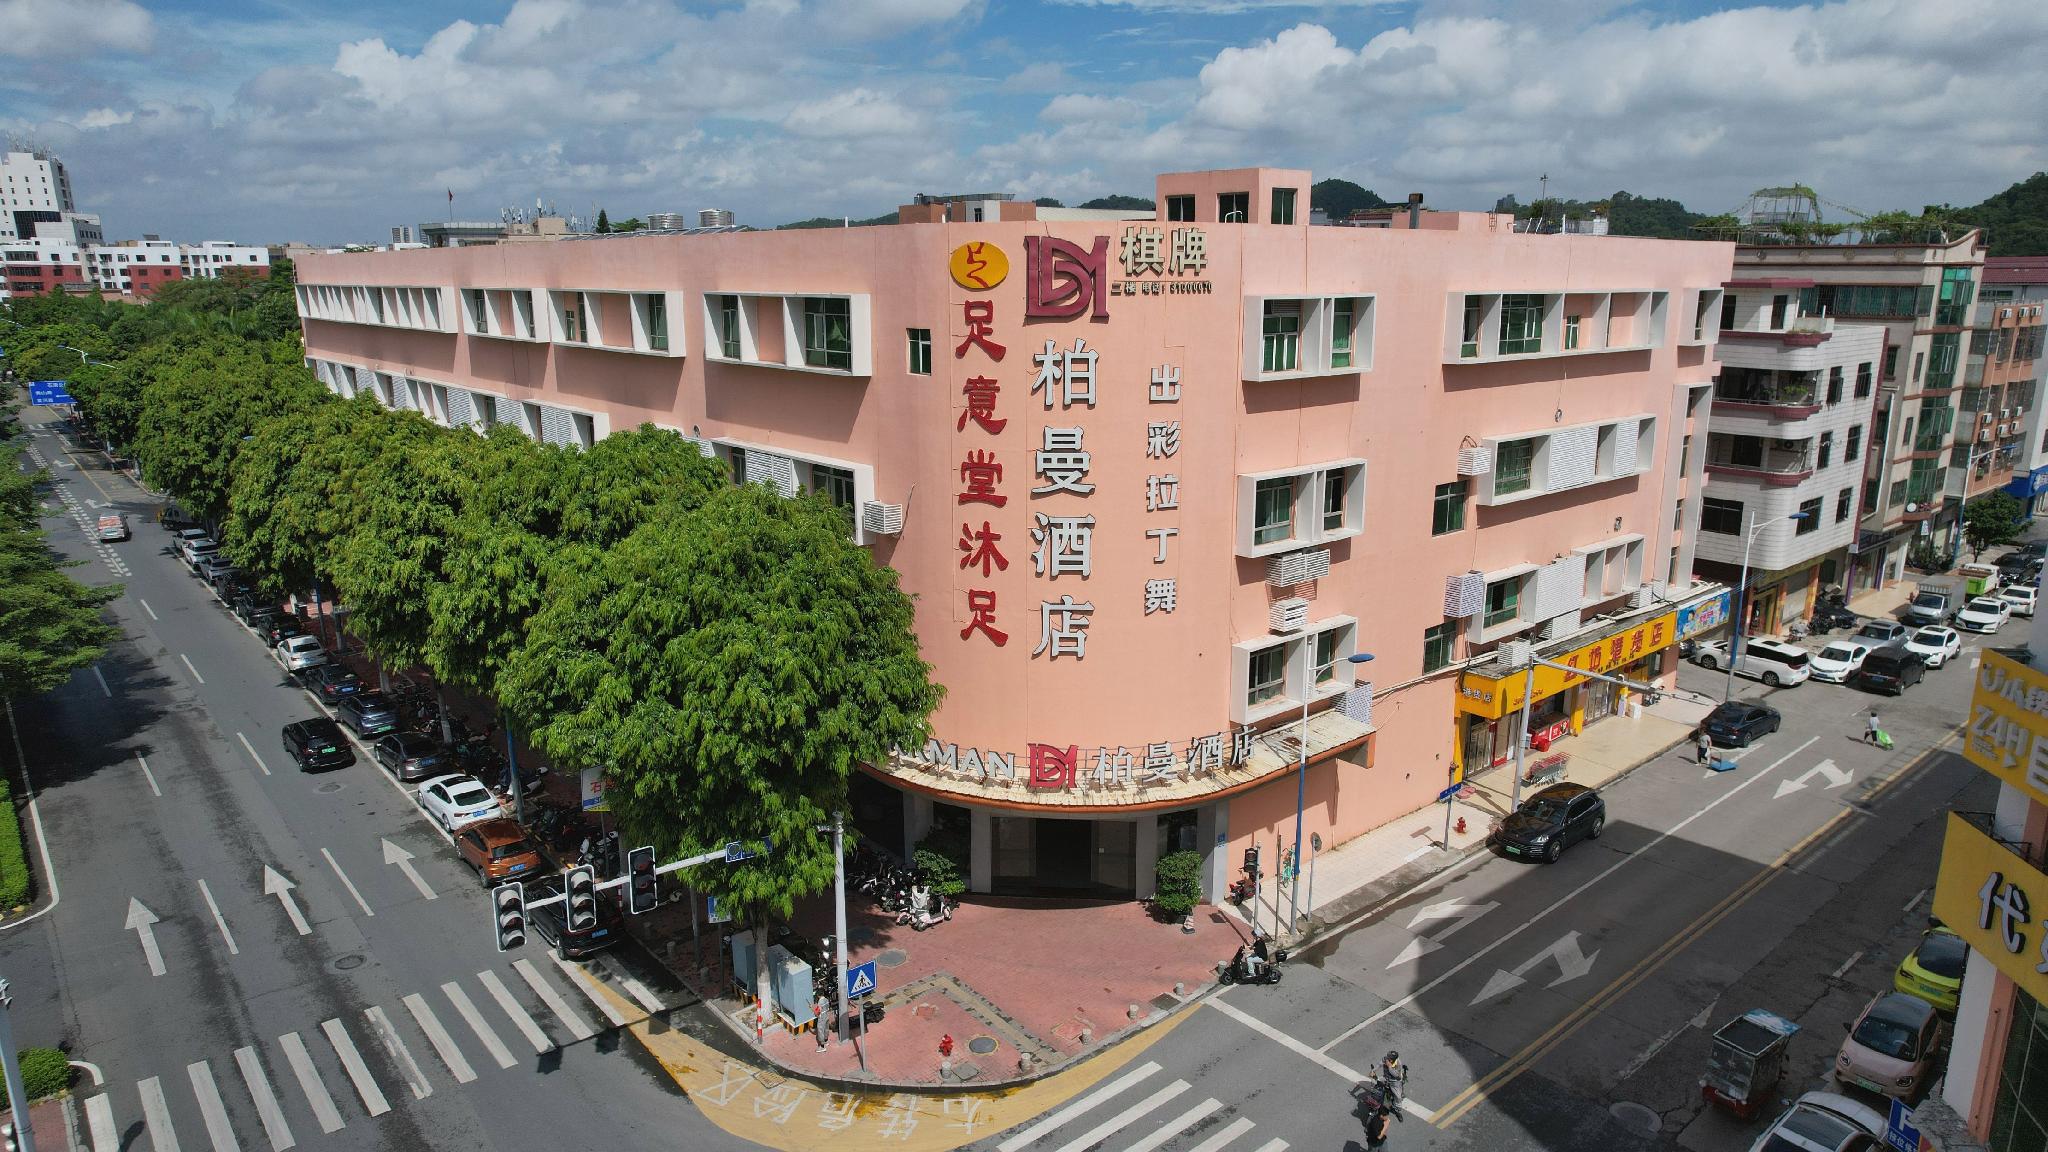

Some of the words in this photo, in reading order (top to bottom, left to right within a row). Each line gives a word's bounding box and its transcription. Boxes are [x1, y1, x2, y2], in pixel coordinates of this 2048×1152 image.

[1120, 226, 1208, 276] 棋牌
[955, 300, 1009, 647] 足意堂沐足
[1031, 338, 1099, 660] 柏曼酒店
[1145, 363, 1182, 615] 出彩拉丁舞
[1092, 726, 1257, 786] 柏曼酒店
